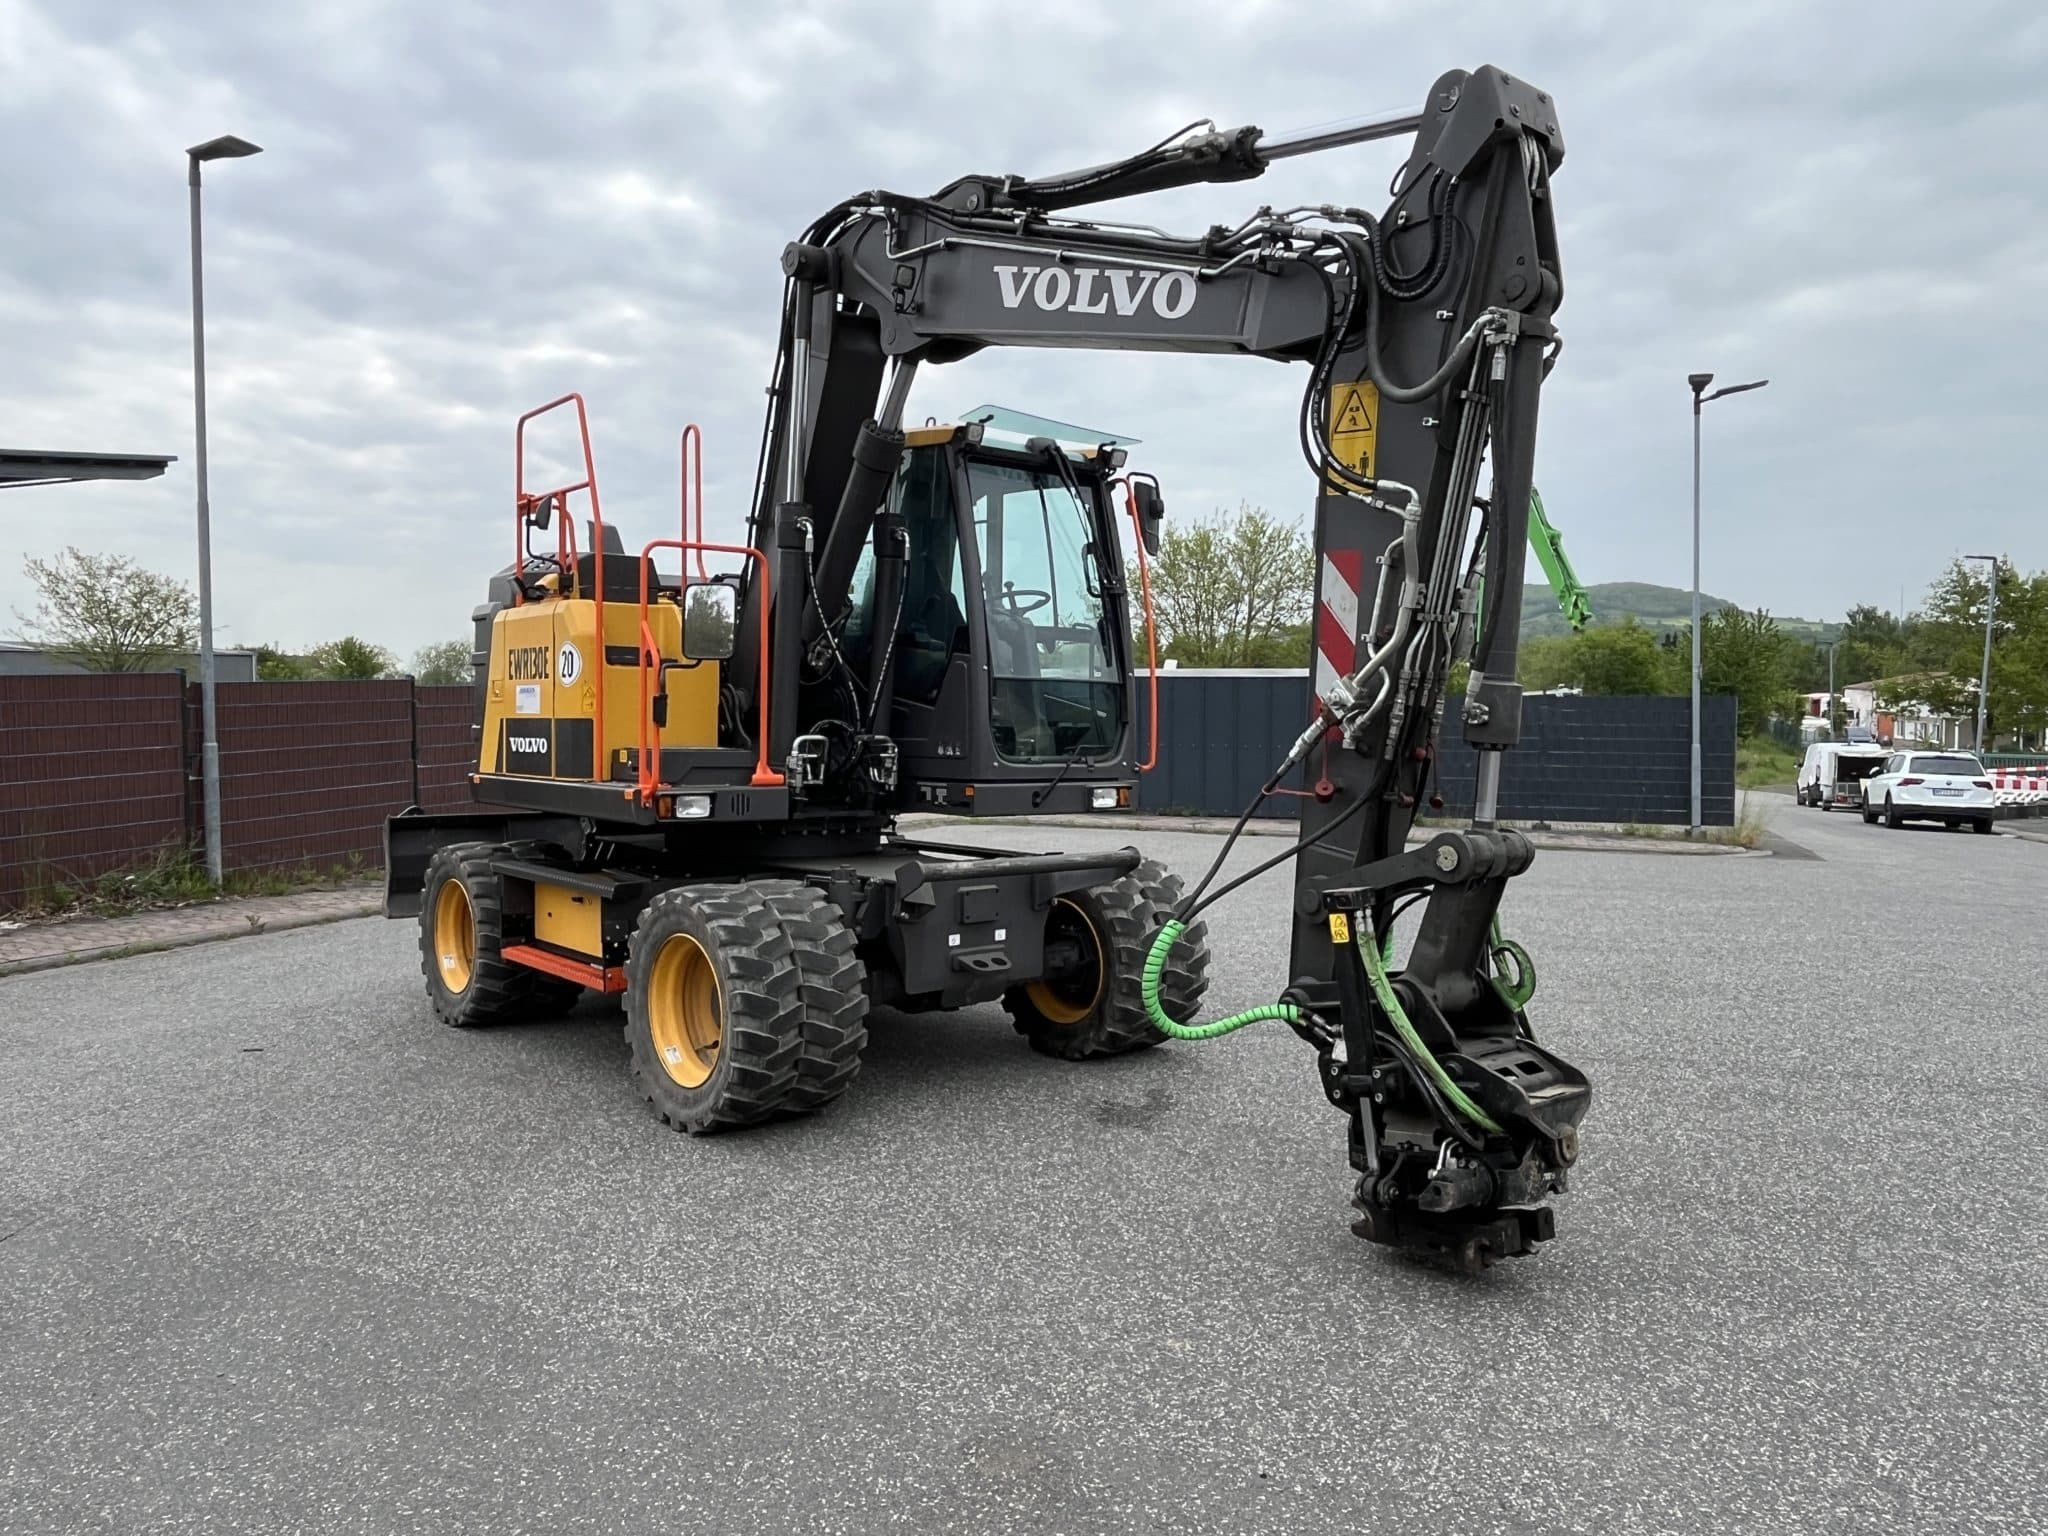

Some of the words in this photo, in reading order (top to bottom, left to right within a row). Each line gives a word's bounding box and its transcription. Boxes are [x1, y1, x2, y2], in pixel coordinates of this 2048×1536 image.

[993, 265, 1197, 319] VOLVO
[508, 646, 549, 680] EWR130E
[562, 650, 574, 678] 20
[509, 737, 548, 754] VOLVO
